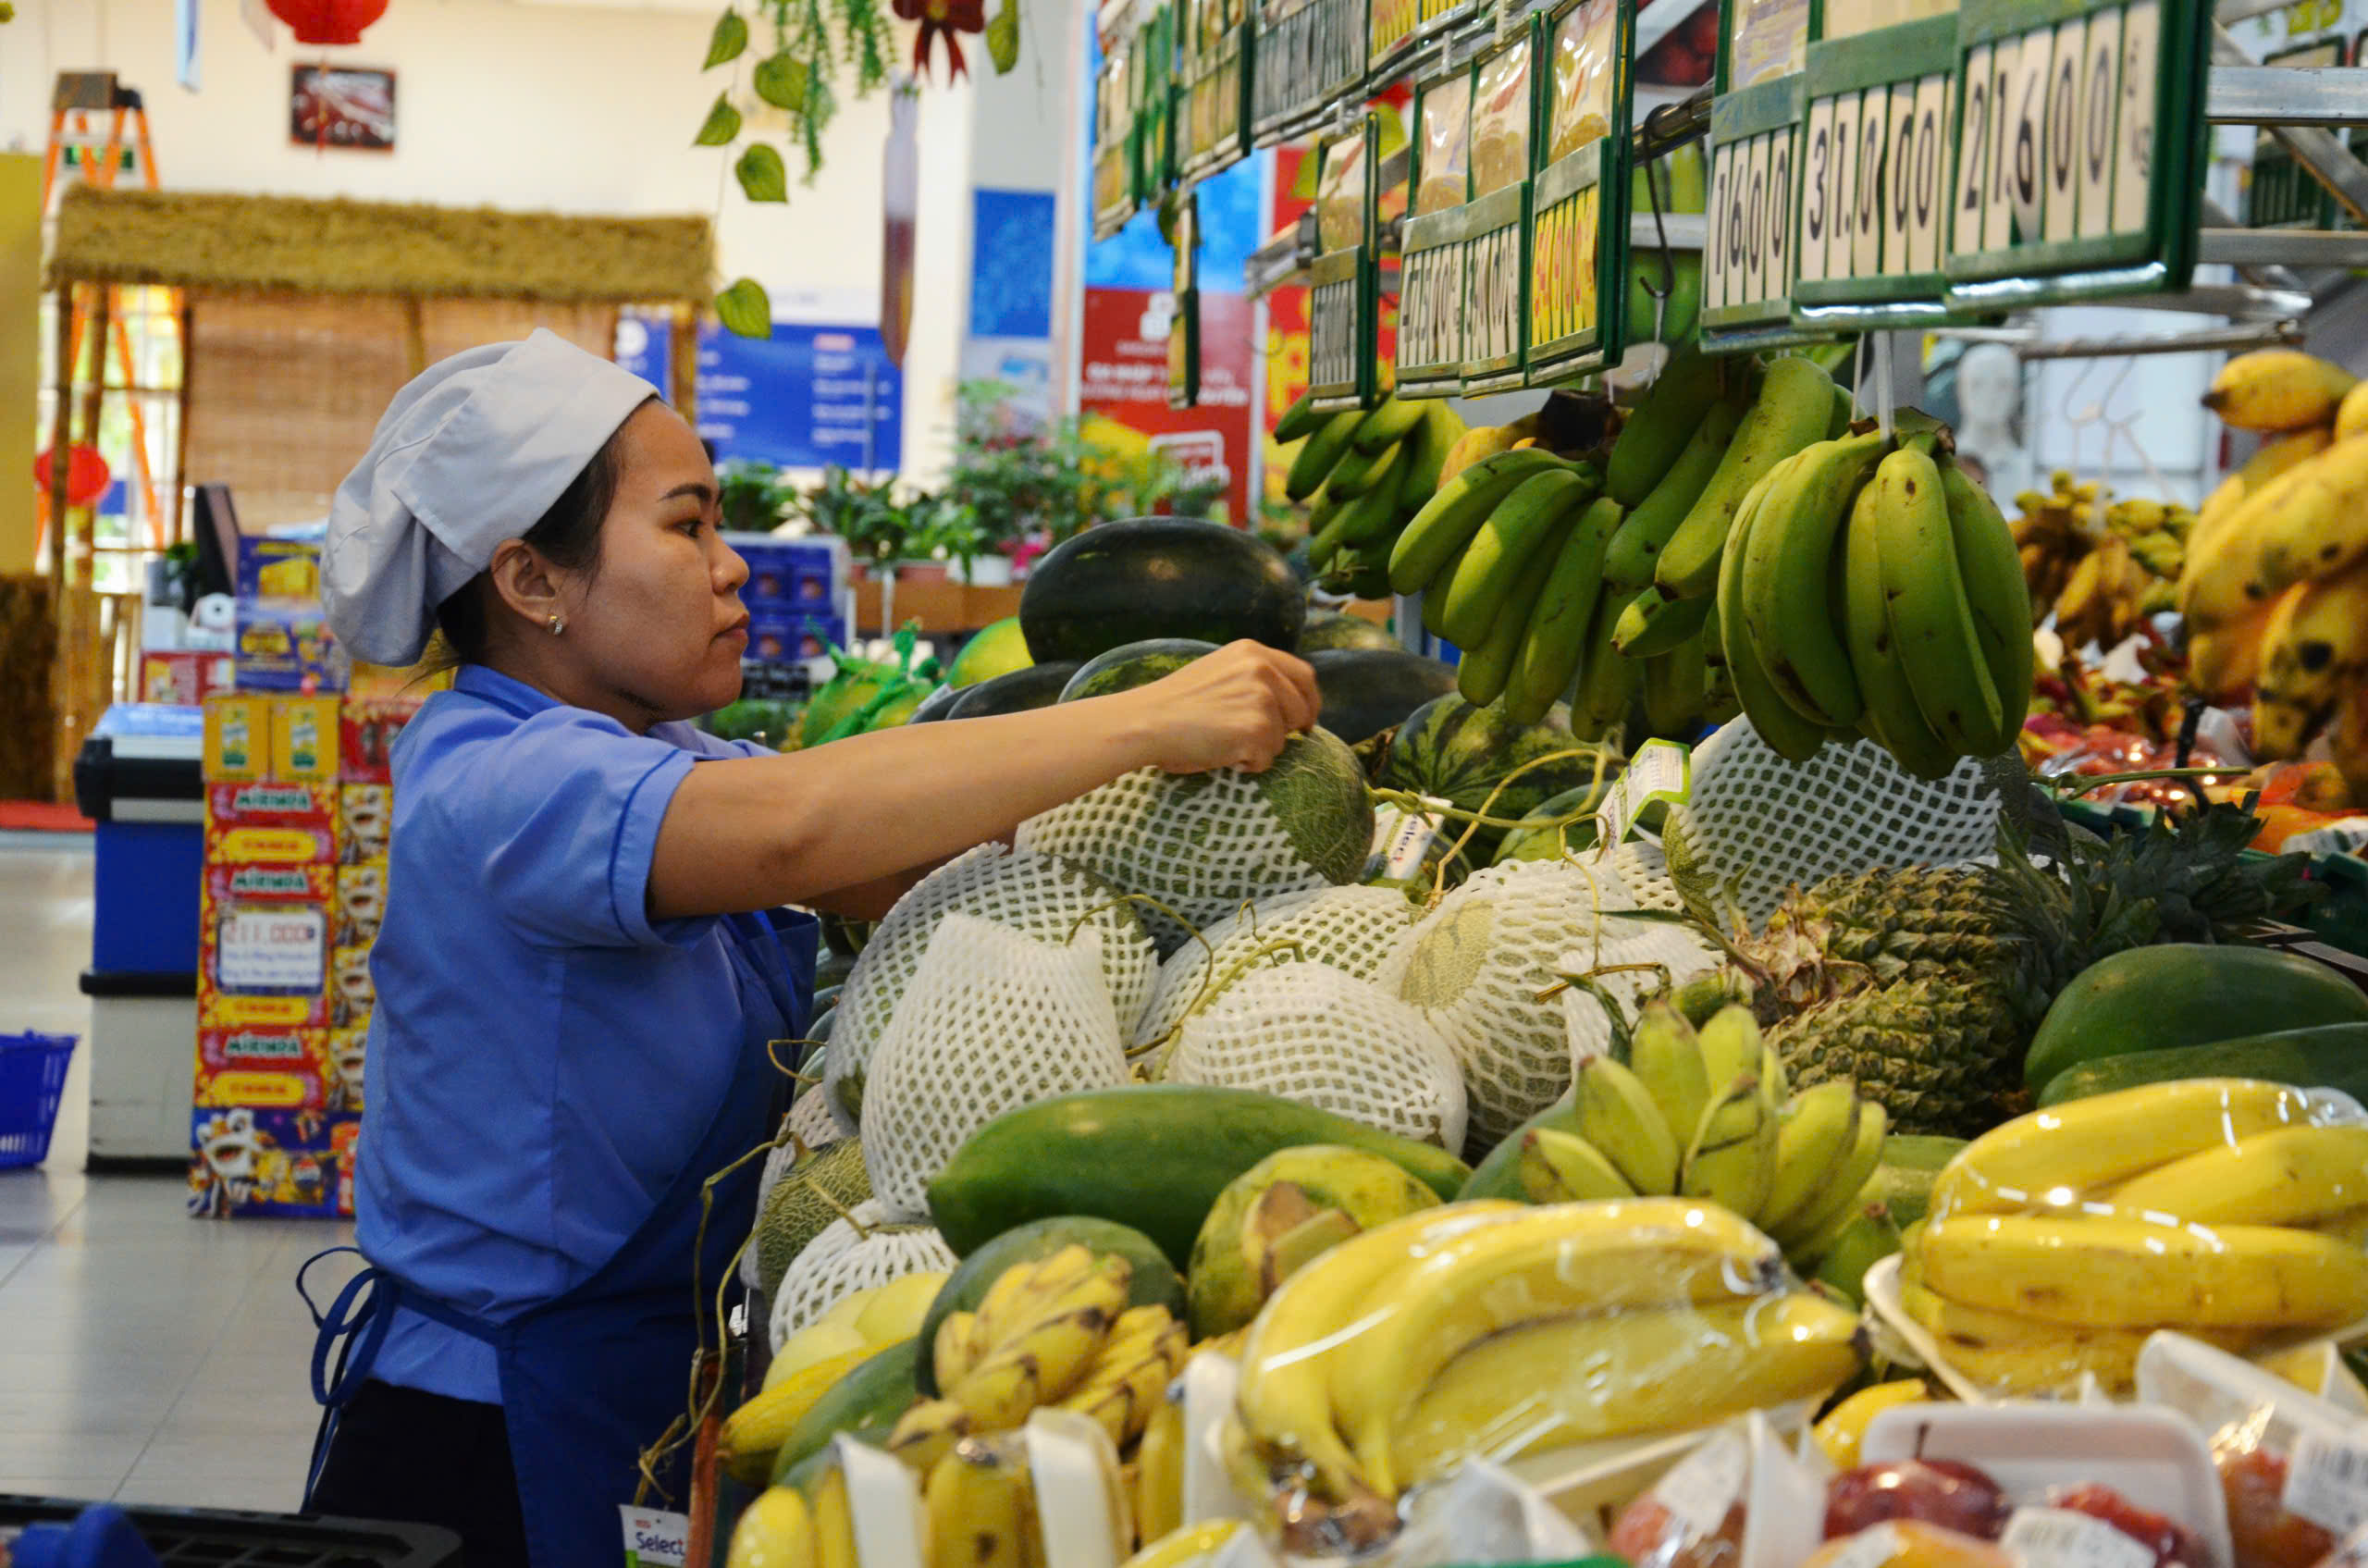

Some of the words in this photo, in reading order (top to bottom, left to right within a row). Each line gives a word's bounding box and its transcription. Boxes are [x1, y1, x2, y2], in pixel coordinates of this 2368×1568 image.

[1809, 108, 1935, 241] 31.000
[1964, 44, 2110, 210] 21.600
[635, 1531, 686, 1556] Select
